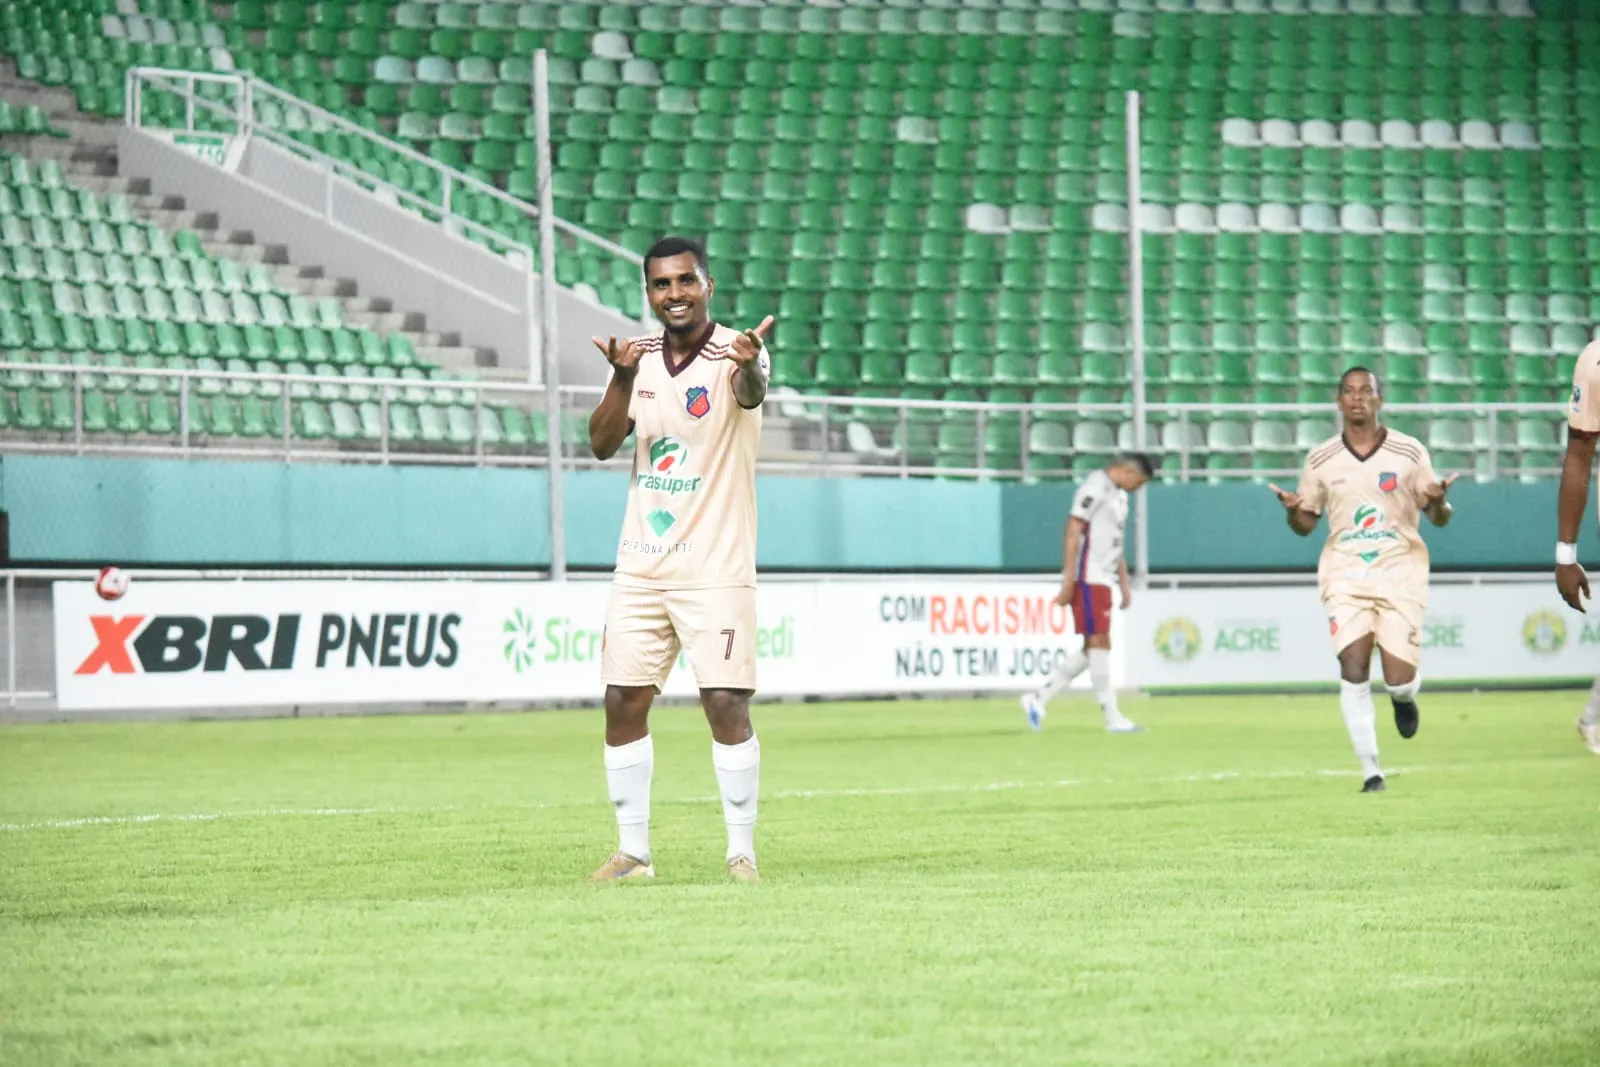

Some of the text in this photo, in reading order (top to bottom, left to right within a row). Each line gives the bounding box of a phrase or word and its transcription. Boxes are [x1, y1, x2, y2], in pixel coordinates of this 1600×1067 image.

[636, 473, 702, 496] rasuper
[622, 539, 663, 555] PERSONA
[879, 594, 1067, 635] COM RACISMO
[74, 613, 462, 675] XBRI PNEUS
[544, 616, 602, 662] Sicr
[719, 629, 736, 660] 7
[1214, 627, 1281, 652] ACRE
[1420, 624, 1465, 649] CRE
[895, 641, 944, 677] NÃO
[953, 648, 998, 676] TEM
